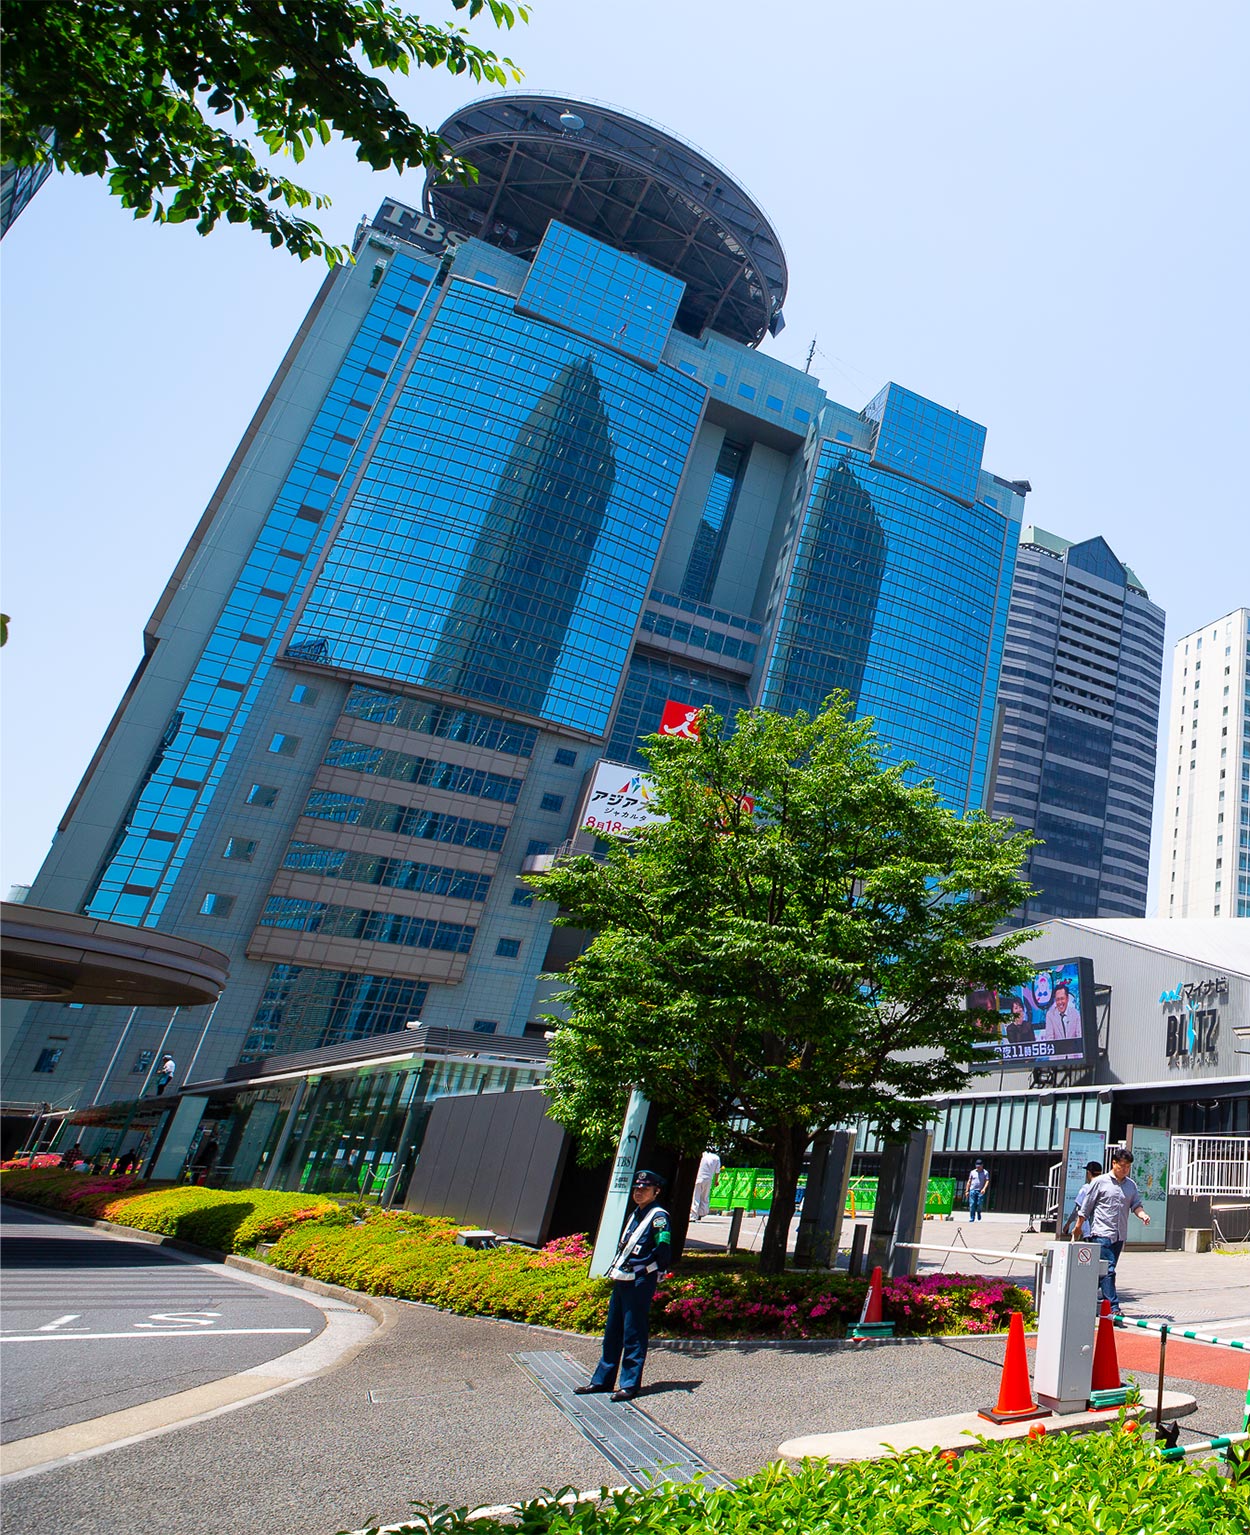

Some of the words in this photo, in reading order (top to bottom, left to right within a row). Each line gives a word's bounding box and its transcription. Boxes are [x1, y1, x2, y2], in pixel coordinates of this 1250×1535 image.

[585, 816, 631, 832] 8月18
[604, 807, 647, 822] ジャカルタ
[1183, 976, 1227, 999] マイナビ
[1165, 1006, 1217, 1057] BLITZ
